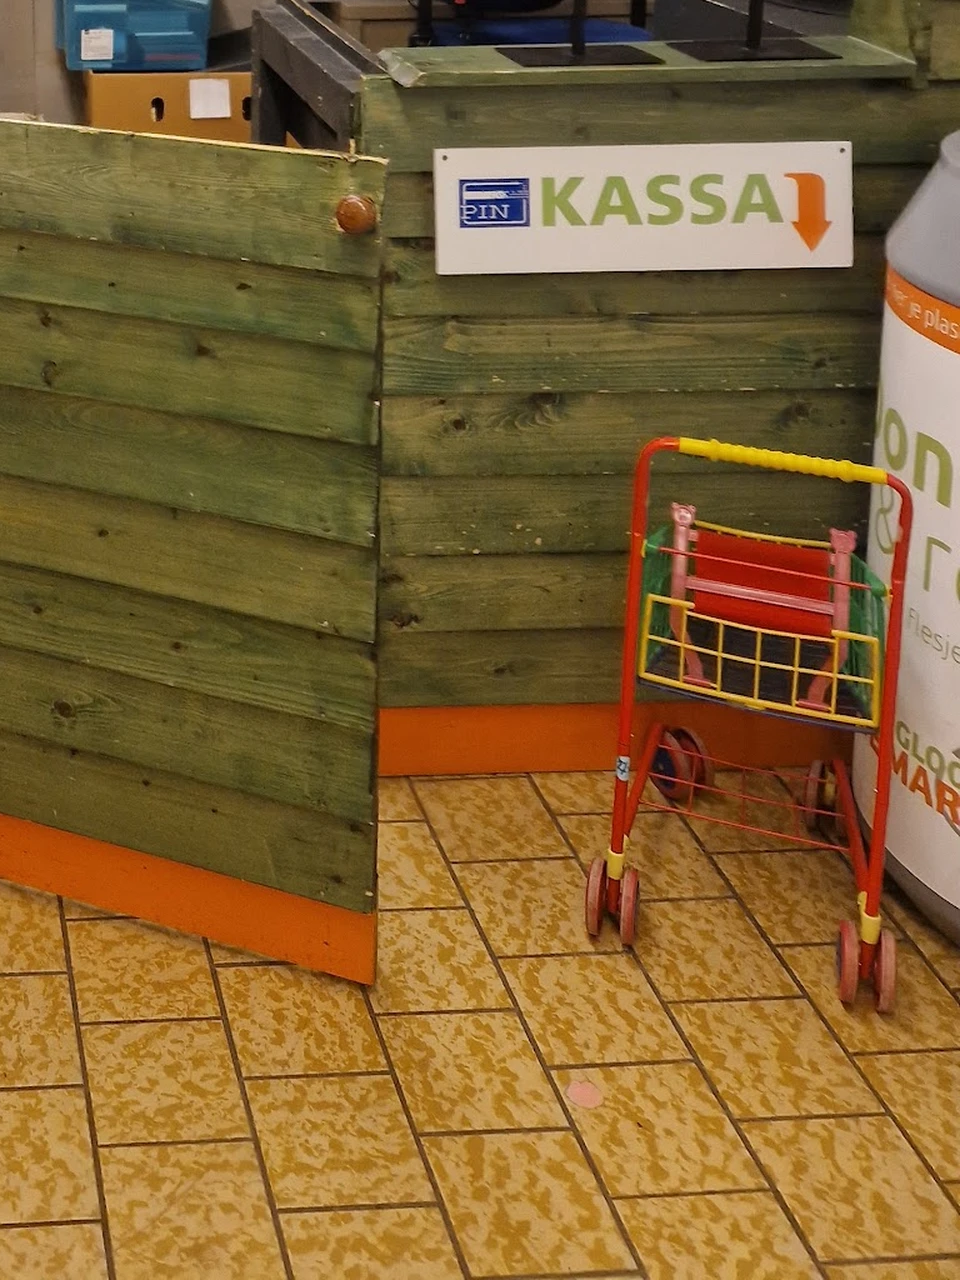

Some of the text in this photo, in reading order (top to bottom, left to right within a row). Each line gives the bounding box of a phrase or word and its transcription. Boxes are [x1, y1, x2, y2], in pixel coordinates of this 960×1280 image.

[460, 204, 509, 220] PIN
[541, 173, 785, 227] KASSA
[924, 308, 960, 339] plas
[907, 607, 960, 665] flesje
